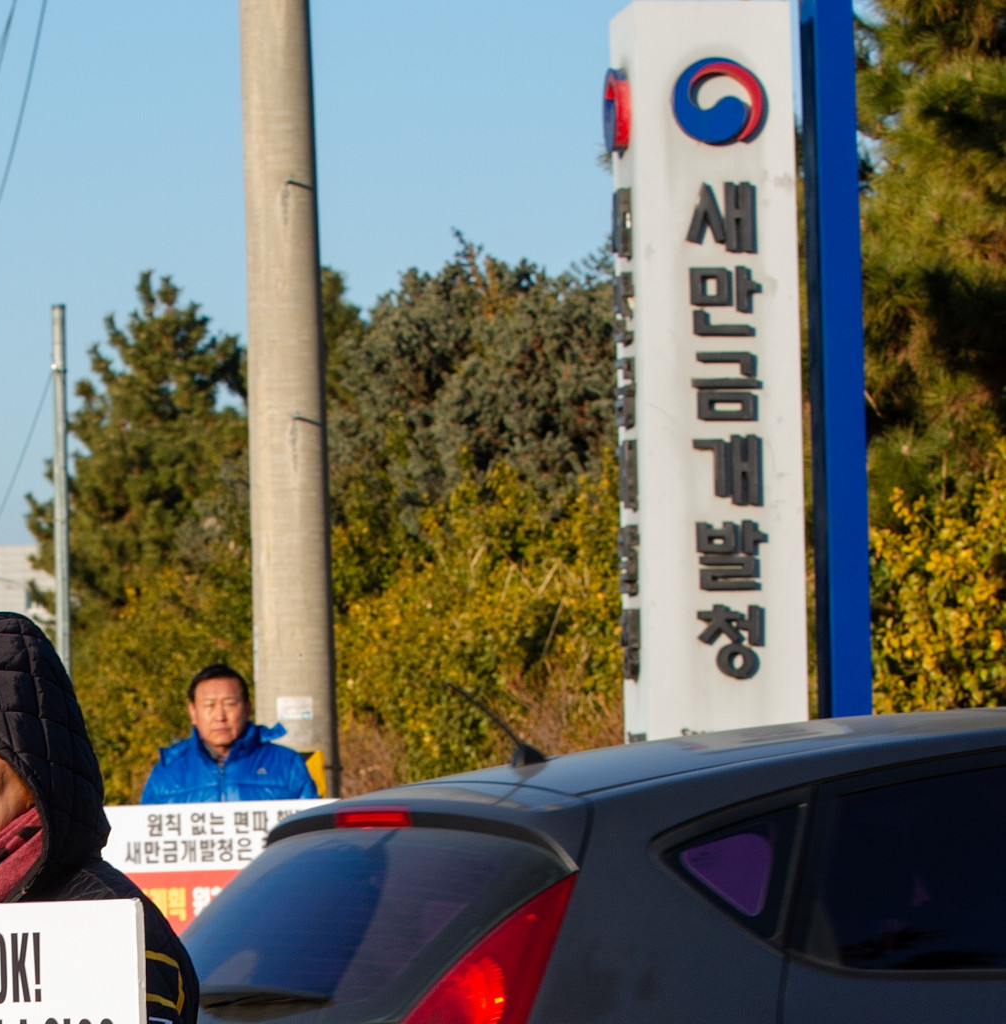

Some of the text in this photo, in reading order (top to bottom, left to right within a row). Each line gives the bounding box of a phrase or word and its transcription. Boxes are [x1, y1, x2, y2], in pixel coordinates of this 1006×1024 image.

[686, 182, 769, 680] 새만금개발청
[147, 814, 182, 837] 원칙
[190, 812, 225, 836] 없는
[234, 811, 269, 834] 편파
[125, 837, 253, 864] 새만금개발청은
